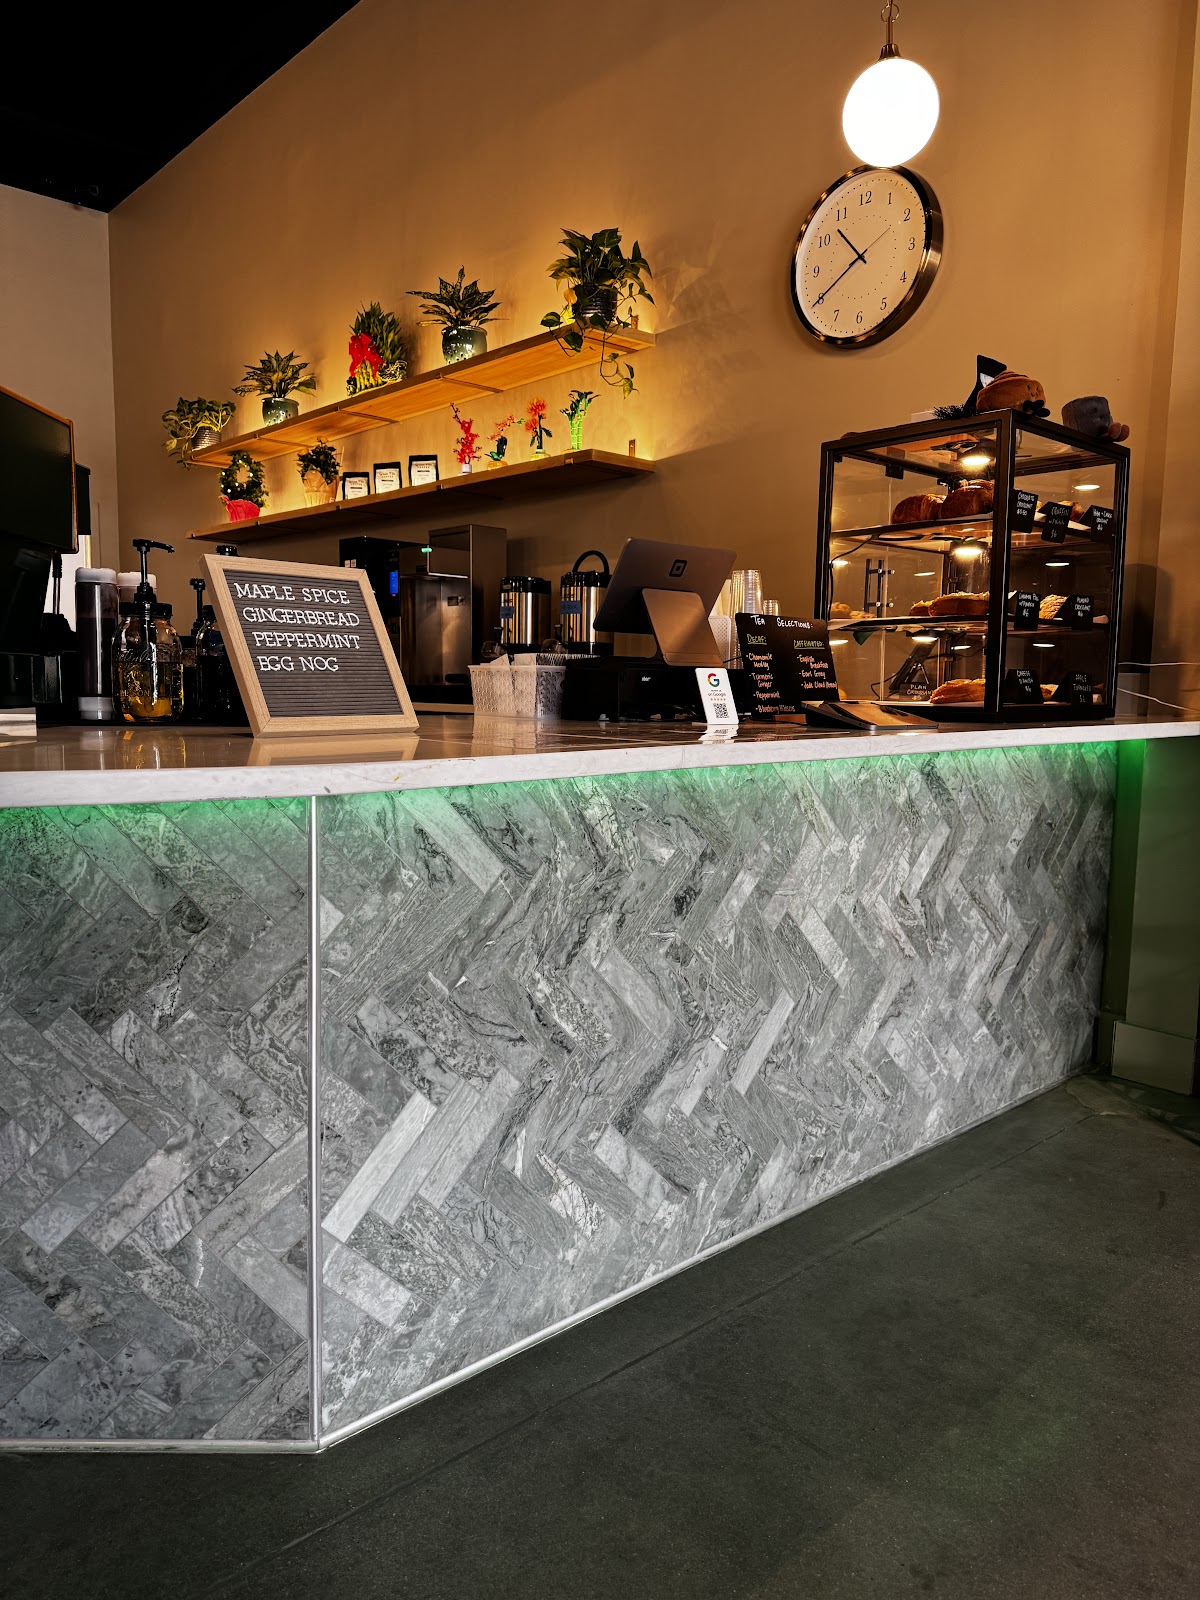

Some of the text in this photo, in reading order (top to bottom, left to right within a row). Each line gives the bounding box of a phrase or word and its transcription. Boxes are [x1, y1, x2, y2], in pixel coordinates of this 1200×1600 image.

[858, 190, 872, 206] 12
[886, 192, 892, 205] 1
[836, 207, 848, 222] 11
[903, 208, 911, 222] 2
[818, 234, 831, 248] 10
[908, 237, 916, 250] 3
[812, 266, 820, 278] 9
[900, 271, 907, 282] 4
[817, 292, 824, 304] 8
[880, 297, 888, 310] 5
[833, 310, 840, 322] 7
[856, 311, 863, 324] 6
[234, 582, 350, 604] MAPLE SPICE
[242, 606, 360, 627] GINGERBREAD
[252, 631, 360, 650] PEPPERMINT
[256, 656, 339, 672] EGG NOG
